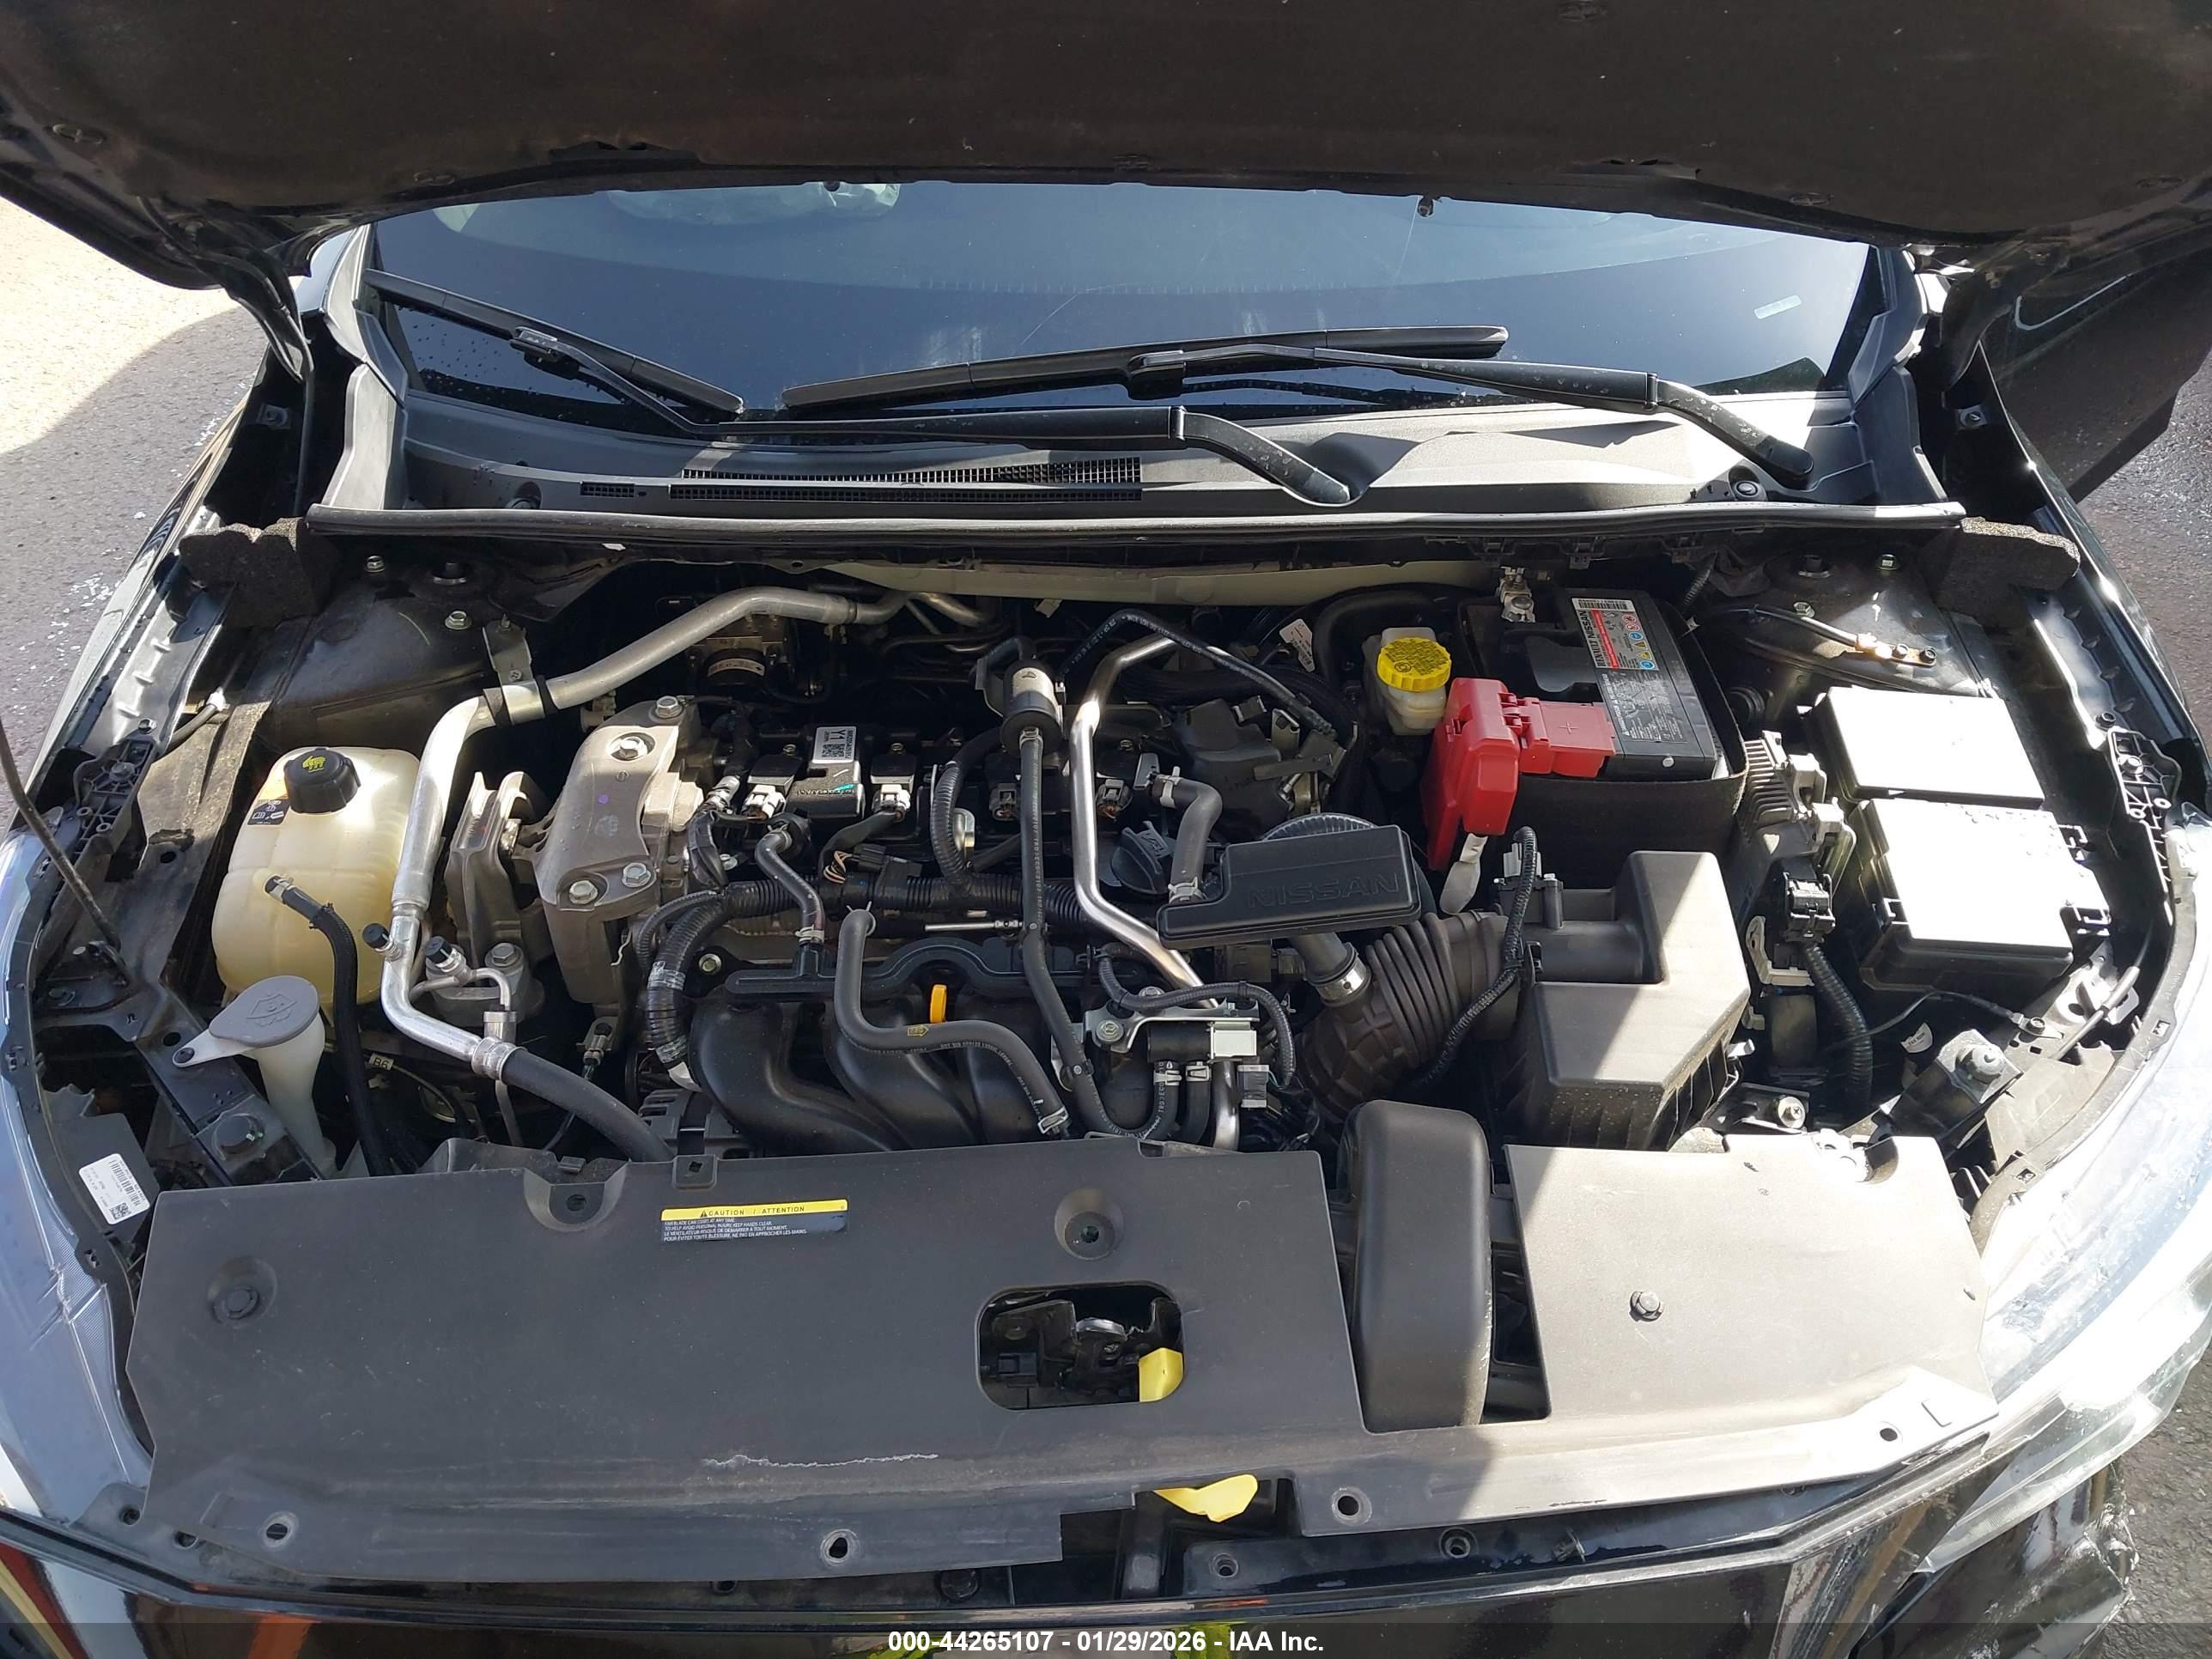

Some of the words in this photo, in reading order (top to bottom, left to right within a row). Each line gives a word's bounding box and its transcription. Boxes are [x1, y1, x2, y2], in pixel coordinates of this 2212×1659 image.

[1579, 611, 1596, 639] NISSAN
[1589, 640, 1607, 666] RENAULT
[830, 729, 846, 740] Y1
[1249, 872, 1399, 908] NISSAN
